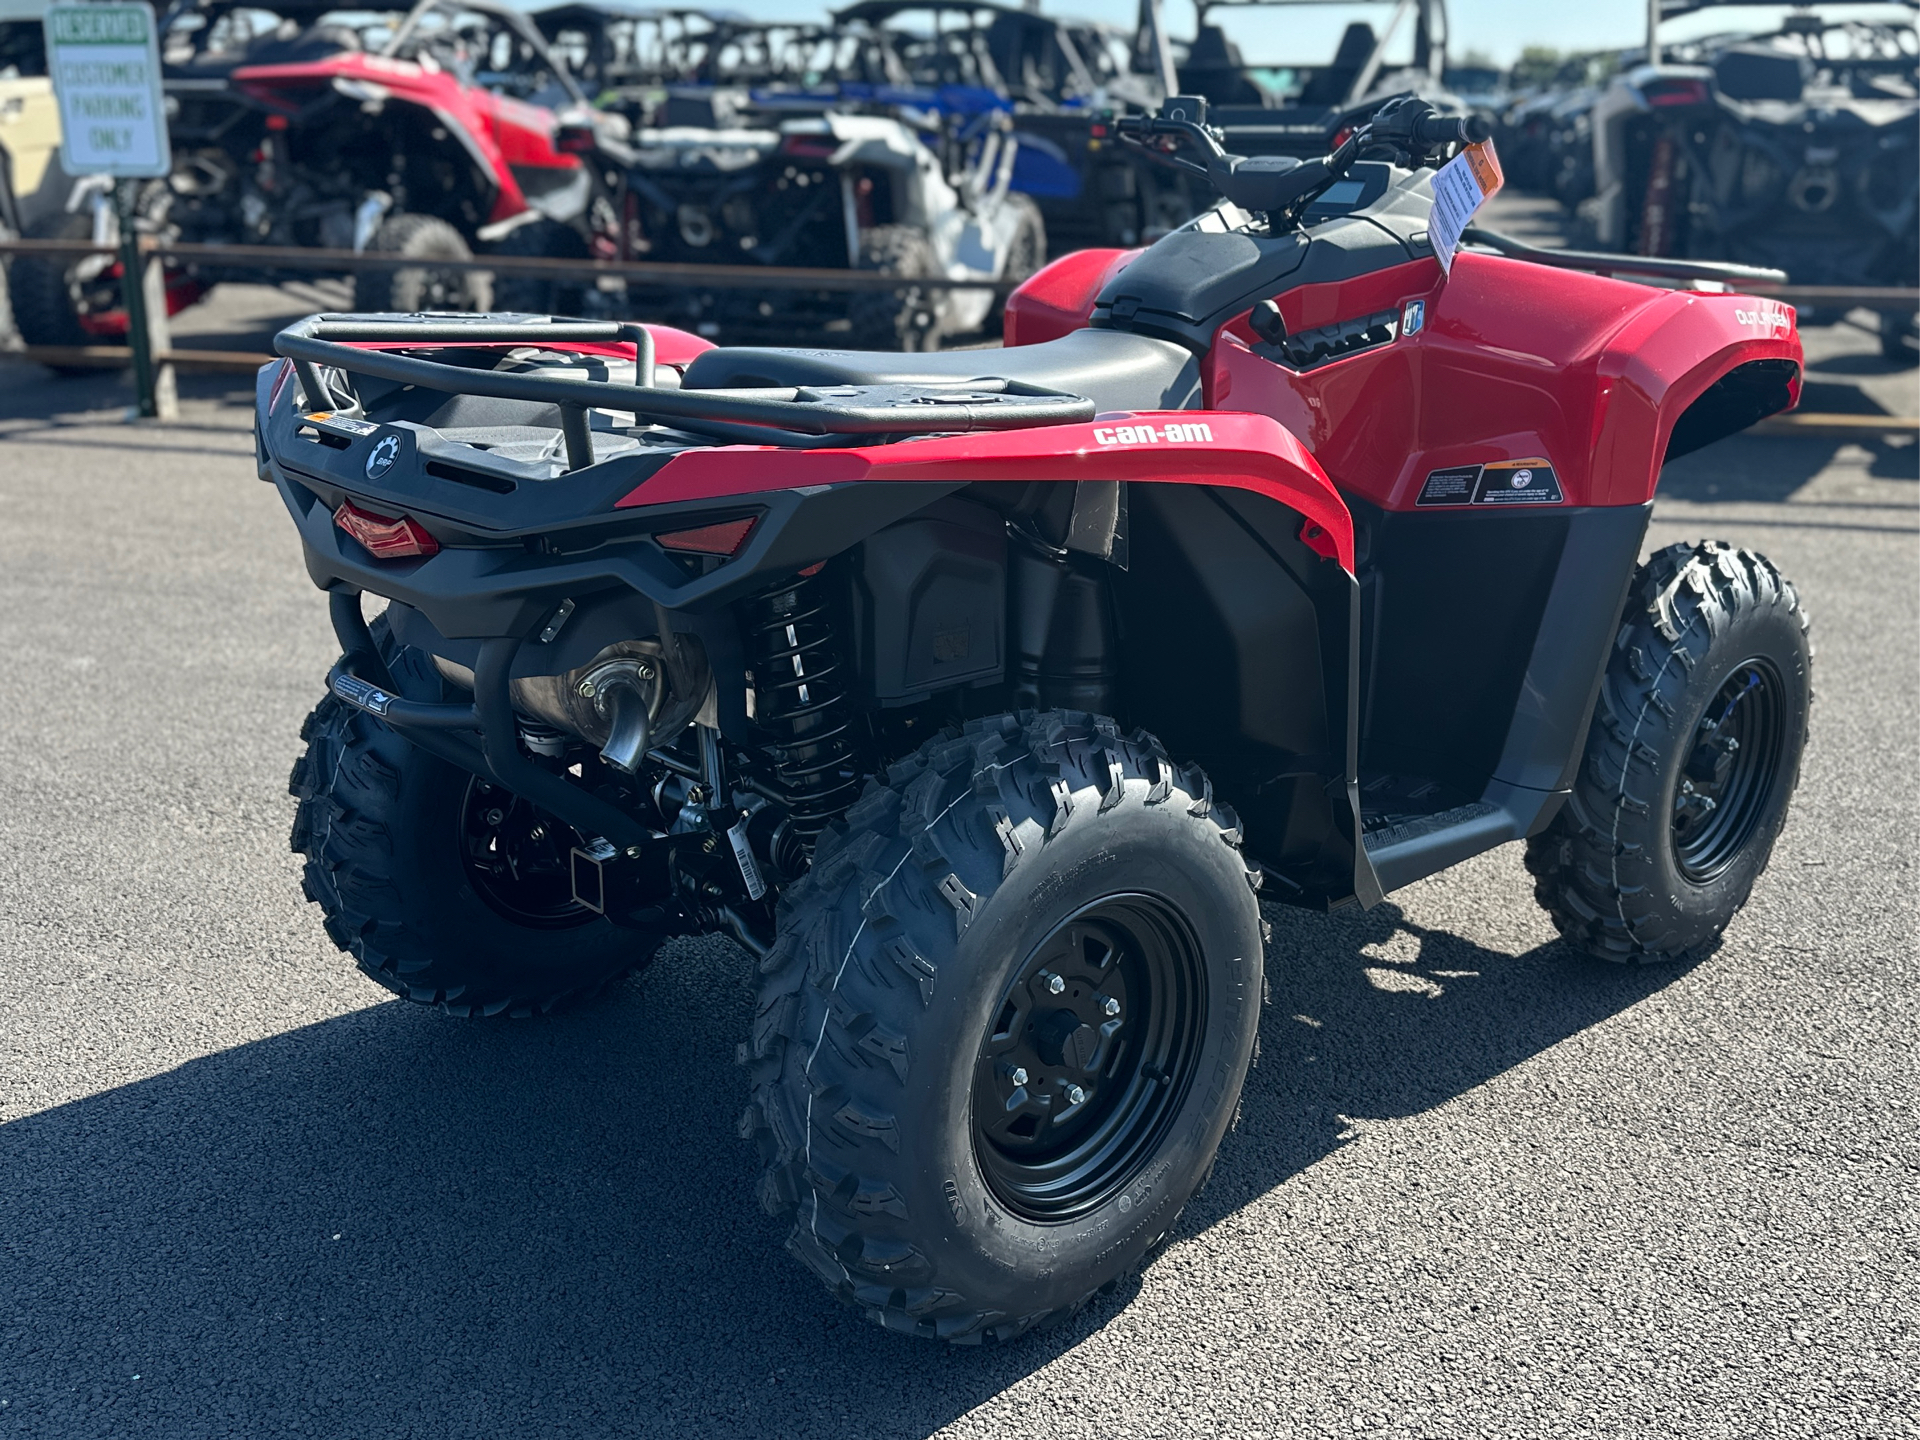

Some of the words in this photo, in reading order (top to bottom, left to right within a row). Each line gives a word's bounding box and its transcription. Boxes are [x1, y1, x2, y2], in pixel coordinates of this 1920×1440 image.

[54, 13, 144, 40] RESERVED
[63, 62, 146, 86] CUSTOMER
[71, 94, 144, 119] PARKING
[88, 127, 133, 151] ONLY
[1093, 423, 1213, 445] can-am
[375, 457, 393, 468] BRP
